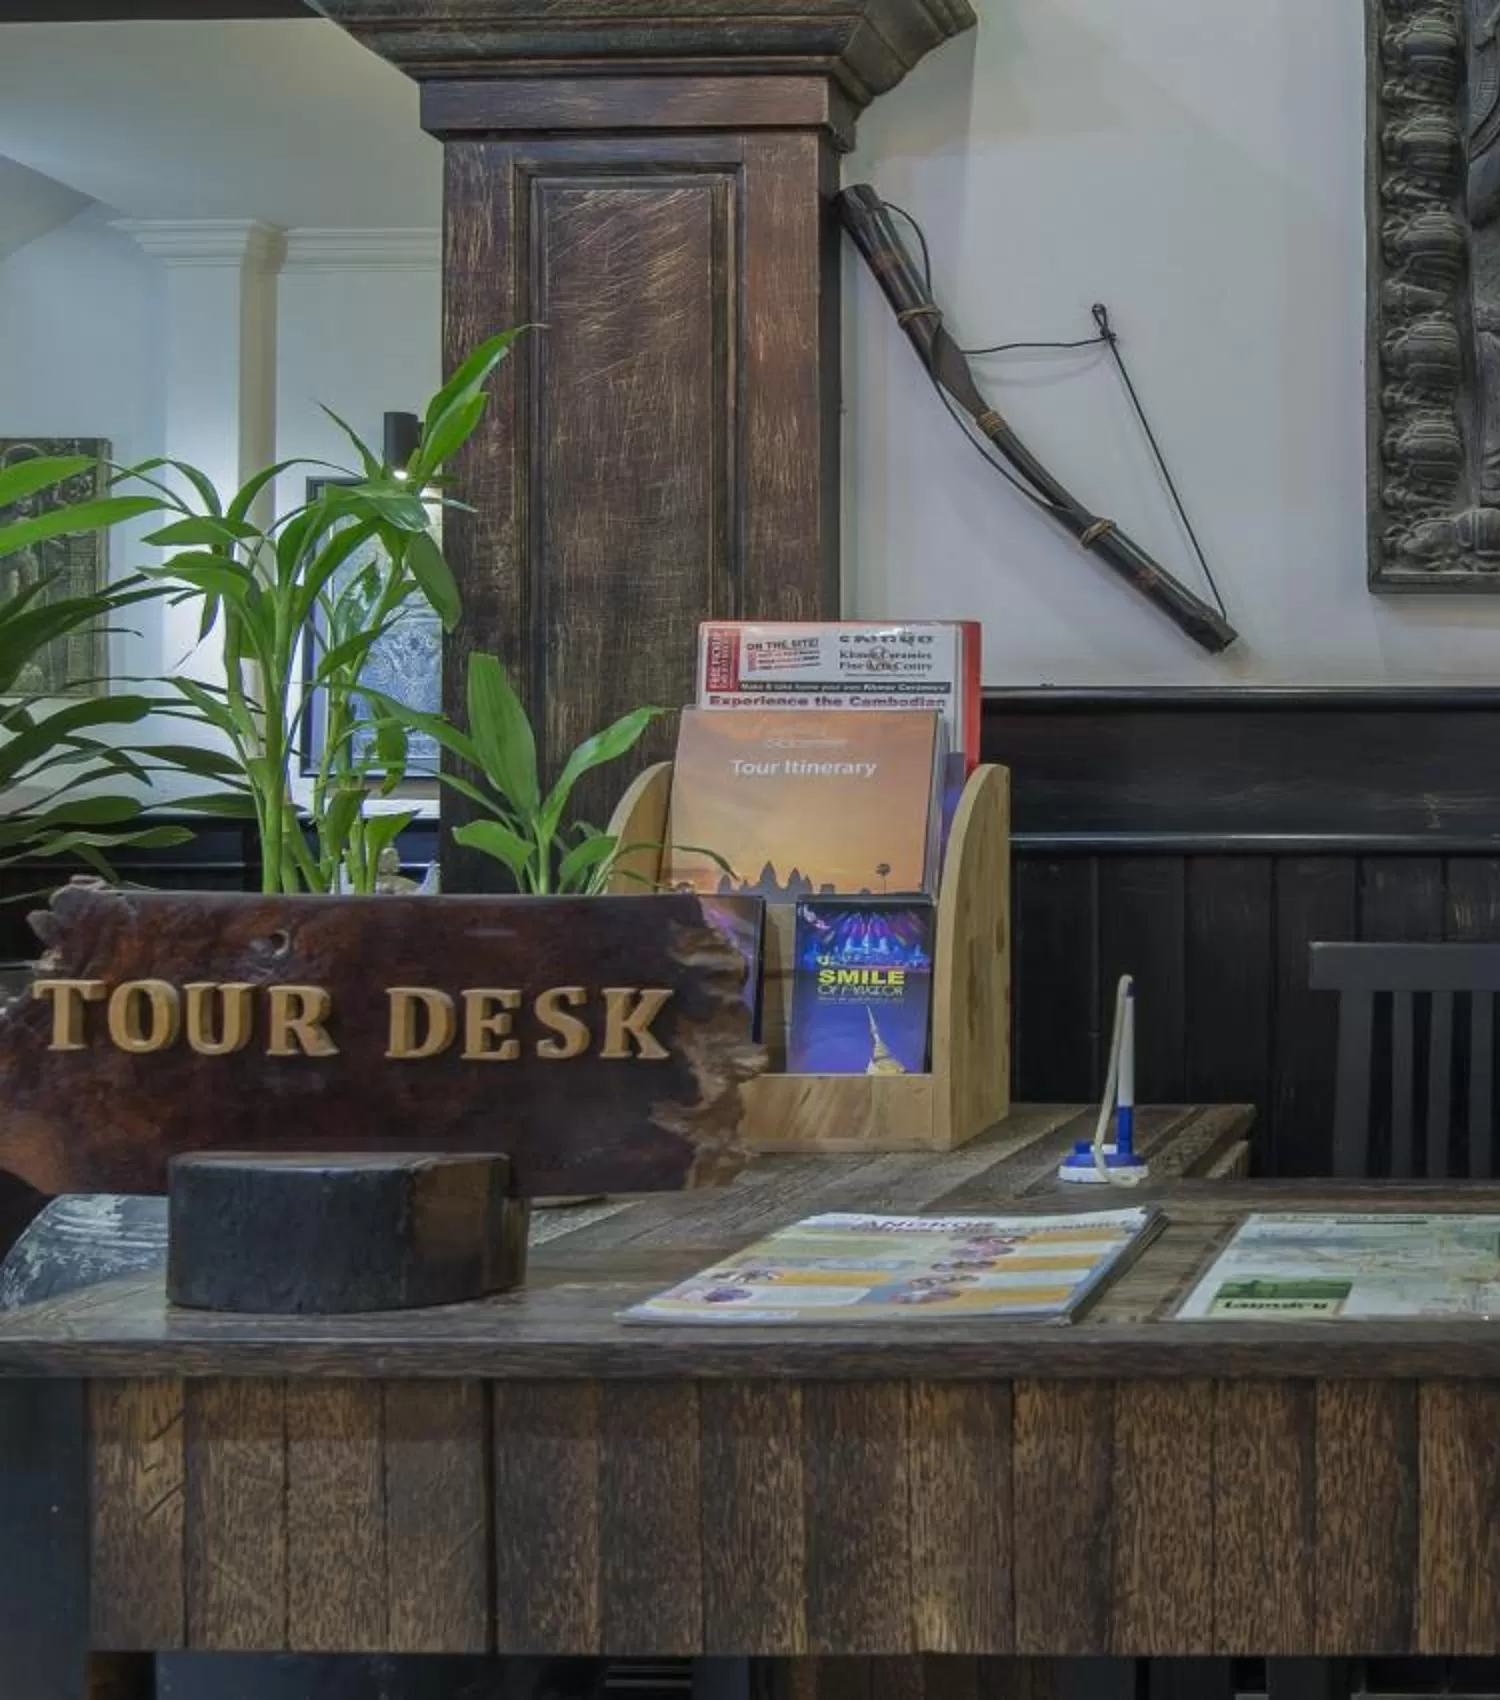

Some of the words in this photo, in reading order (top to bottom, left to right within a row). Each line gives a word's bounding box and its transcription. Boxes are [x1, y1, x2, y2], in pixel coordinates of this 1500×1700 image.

[709, 695, 808, 708] Experience
[816, 696, 842, 706] the
[849, 695, 946, 707] Cambodian
[729, 759, 780, 775] Tour
[785, 759, 878, 777] Itinerary
[818, 969, 905, 985] SMILE
[31, 978, 341, 1057] TOUR
[384, 986, 676, 1062] DESK
